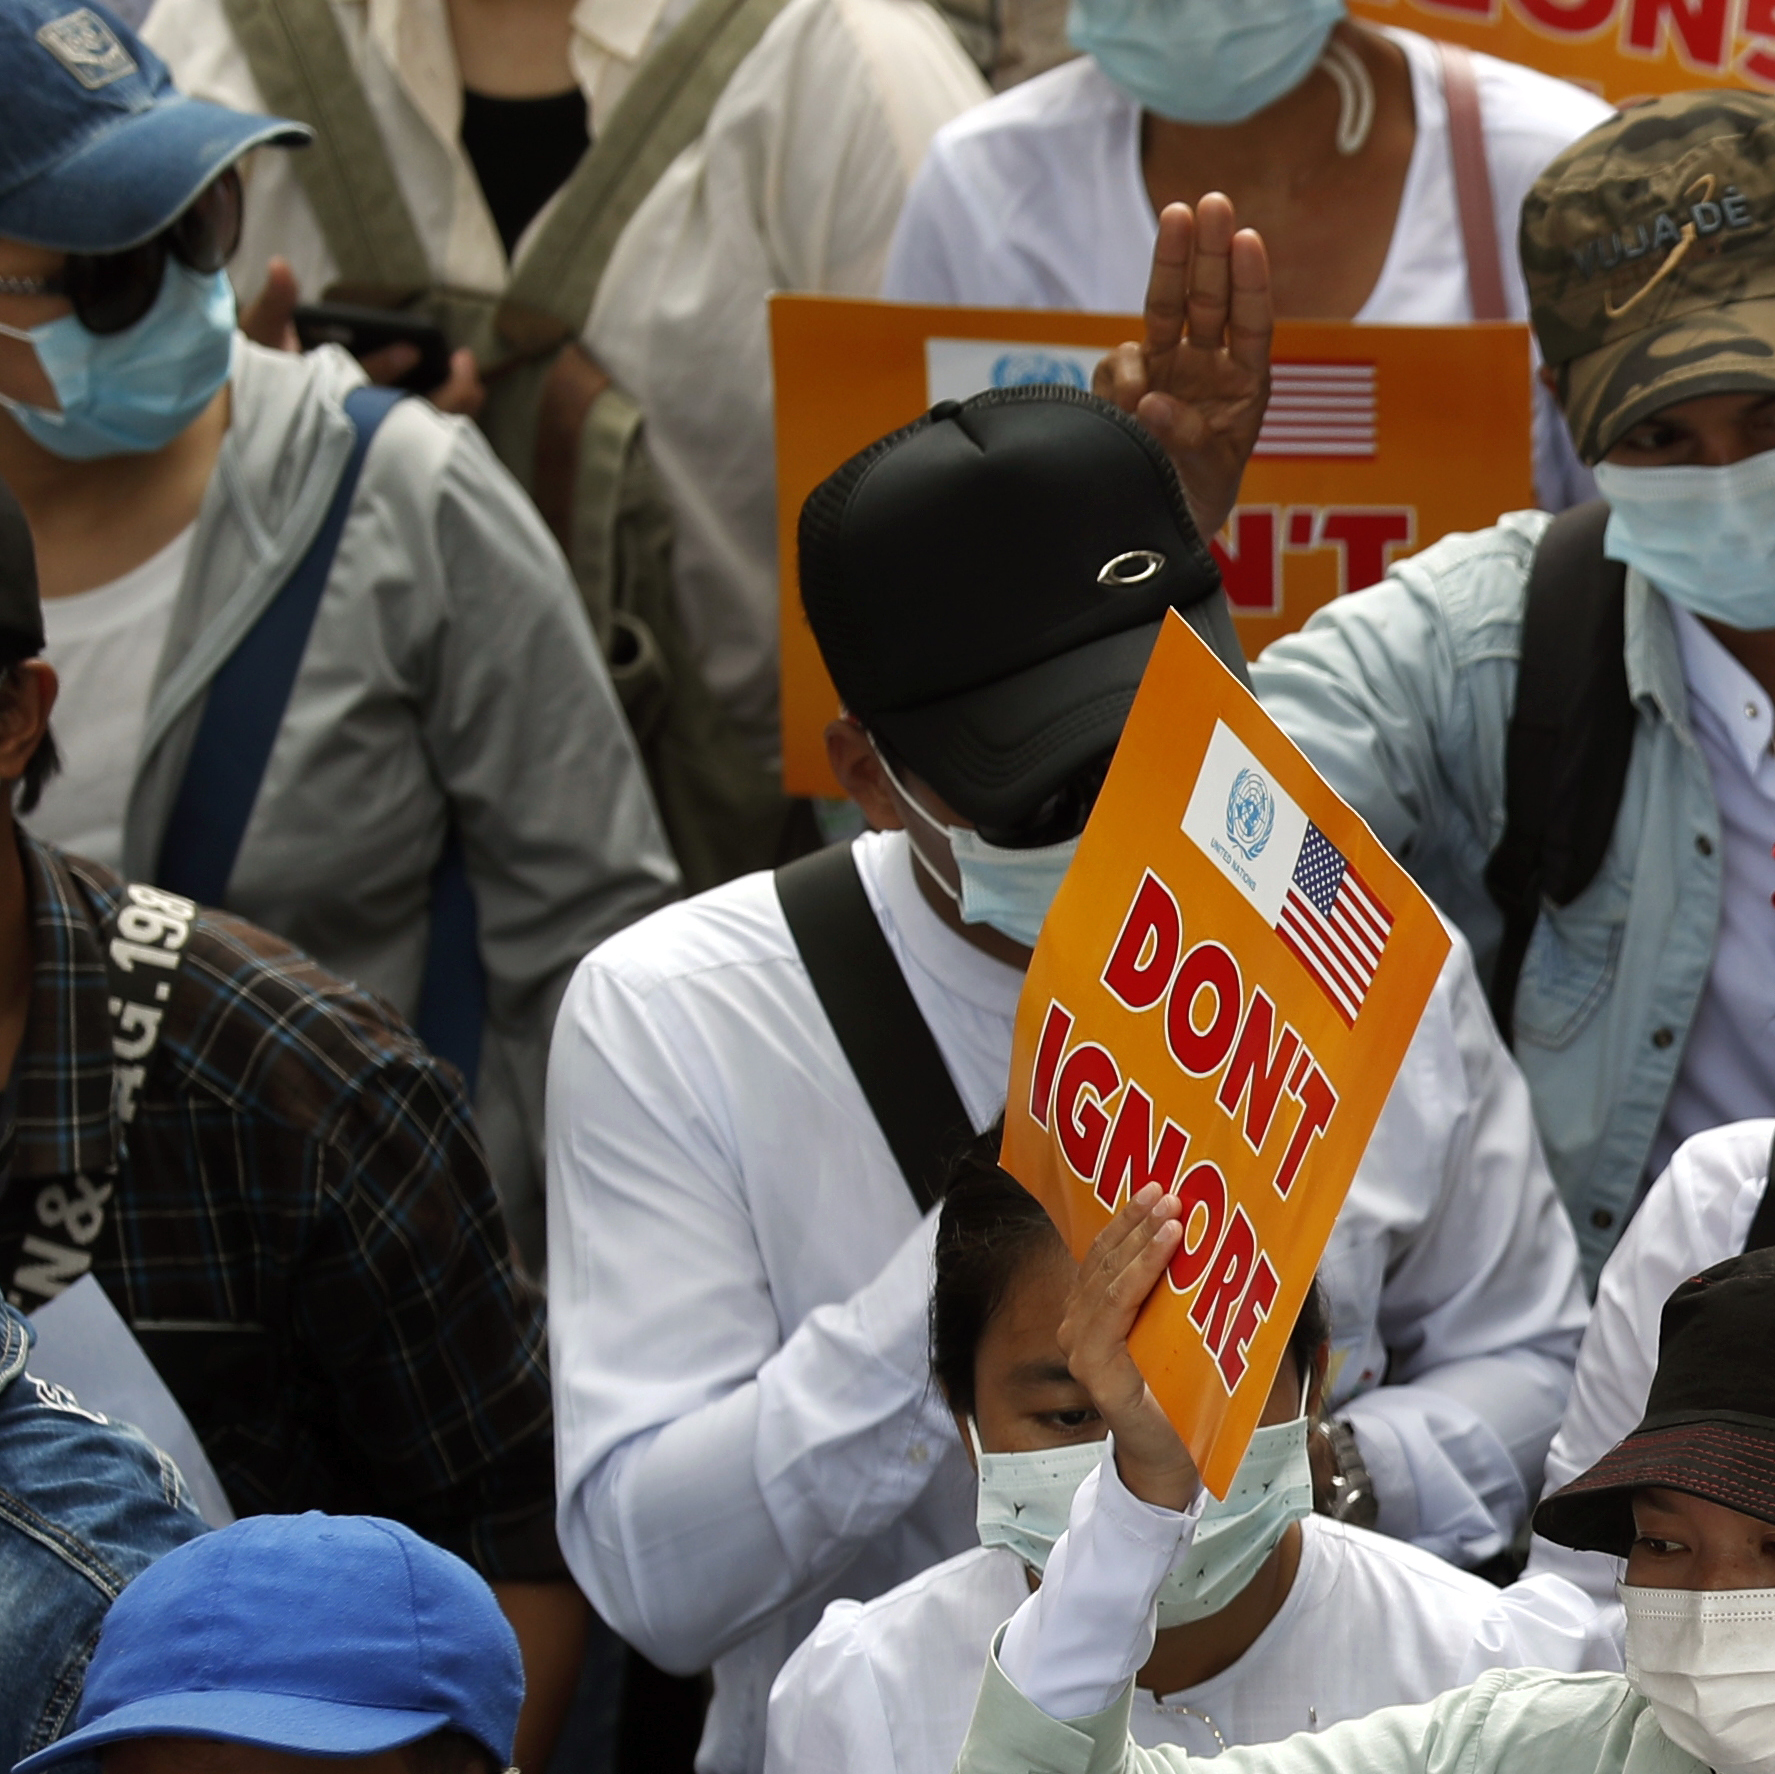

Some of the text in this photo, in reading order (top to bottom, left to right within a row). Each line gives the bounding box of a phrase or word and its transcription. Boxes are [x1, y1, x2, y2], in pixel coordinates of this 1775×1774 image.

[1210, 837, 1257, 892] UNITED NATIONS
[1029, 998, 1280, 1397] IGNORE
[1100, 867, 1339, 1201] DON'T
